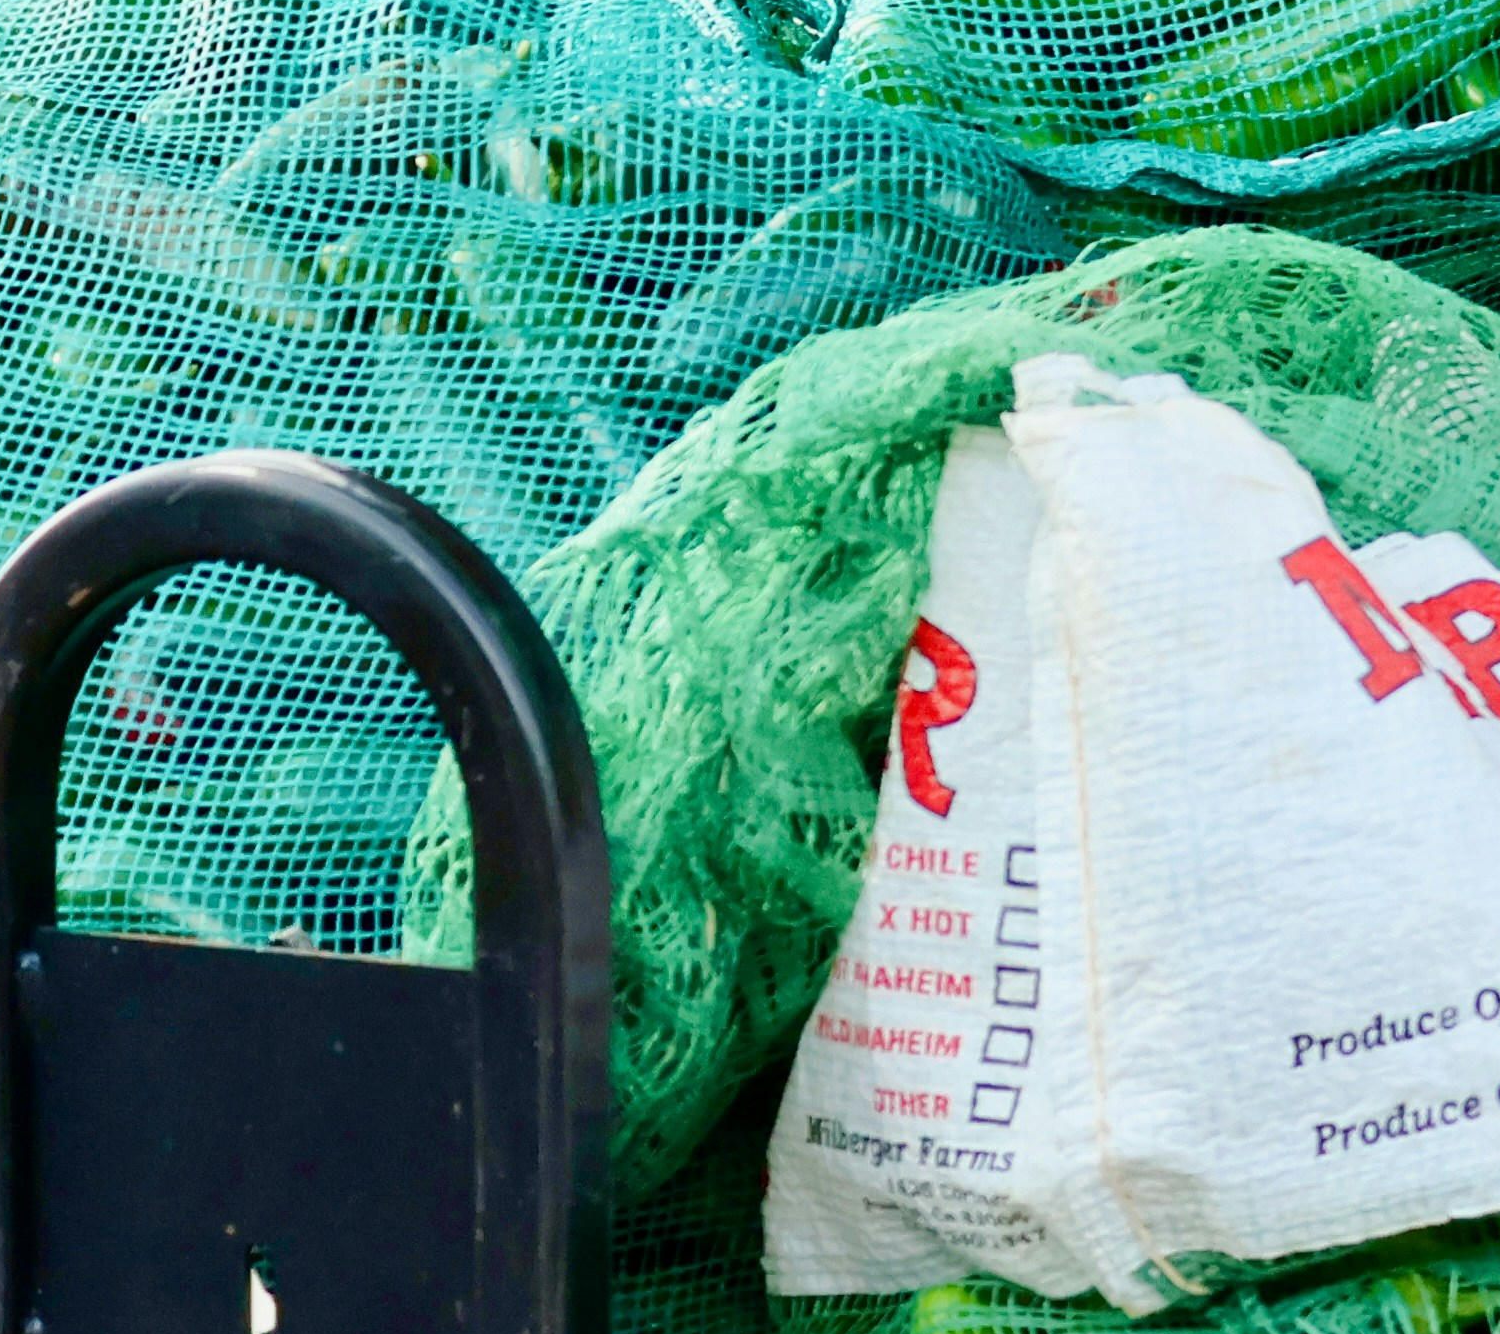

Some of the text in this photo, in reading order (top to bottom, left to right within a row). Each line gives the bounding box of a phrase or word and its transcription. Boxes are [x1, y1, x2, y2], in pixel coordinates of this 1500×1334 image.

[886, 842, 980, 877] CHILE
[878, 903, 974, 938] X HOT
[1289, 1004, 1460, 1068] Produce
[1313, 1093, 1482, 1157] Produce
[917, 1135, 1016, 1172] Farms
